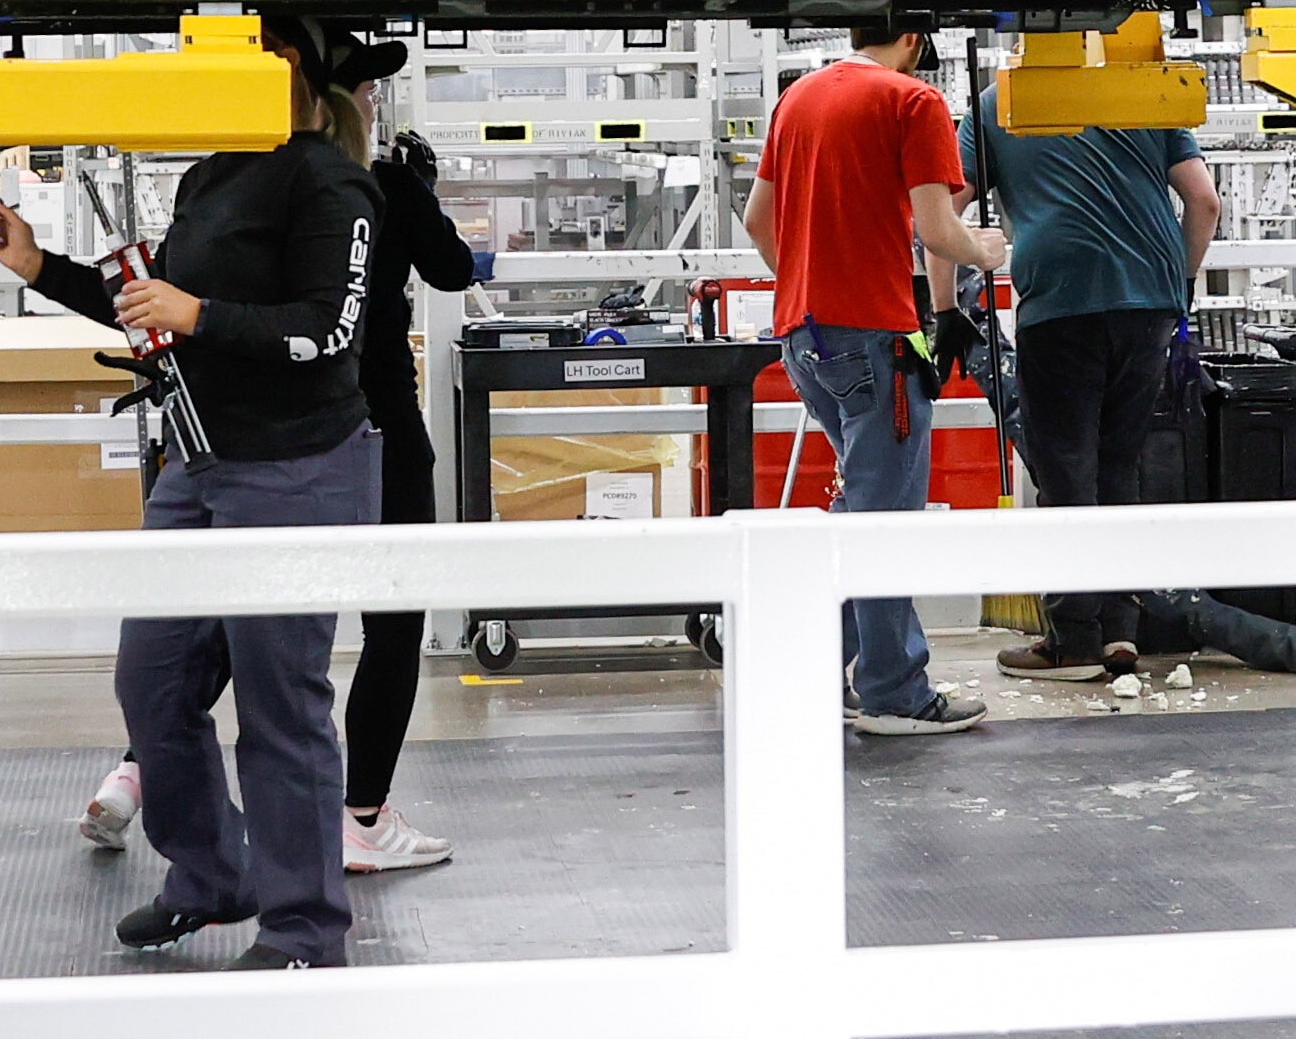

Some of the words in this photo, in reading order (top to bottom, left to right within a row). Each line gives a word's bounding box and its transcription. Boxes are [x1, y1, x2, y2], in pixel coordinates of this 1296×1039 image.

[566, 366, 583, 377] LH
[586, 365, 611, 376] Tool
[614, 364, 640, 376] Cart
